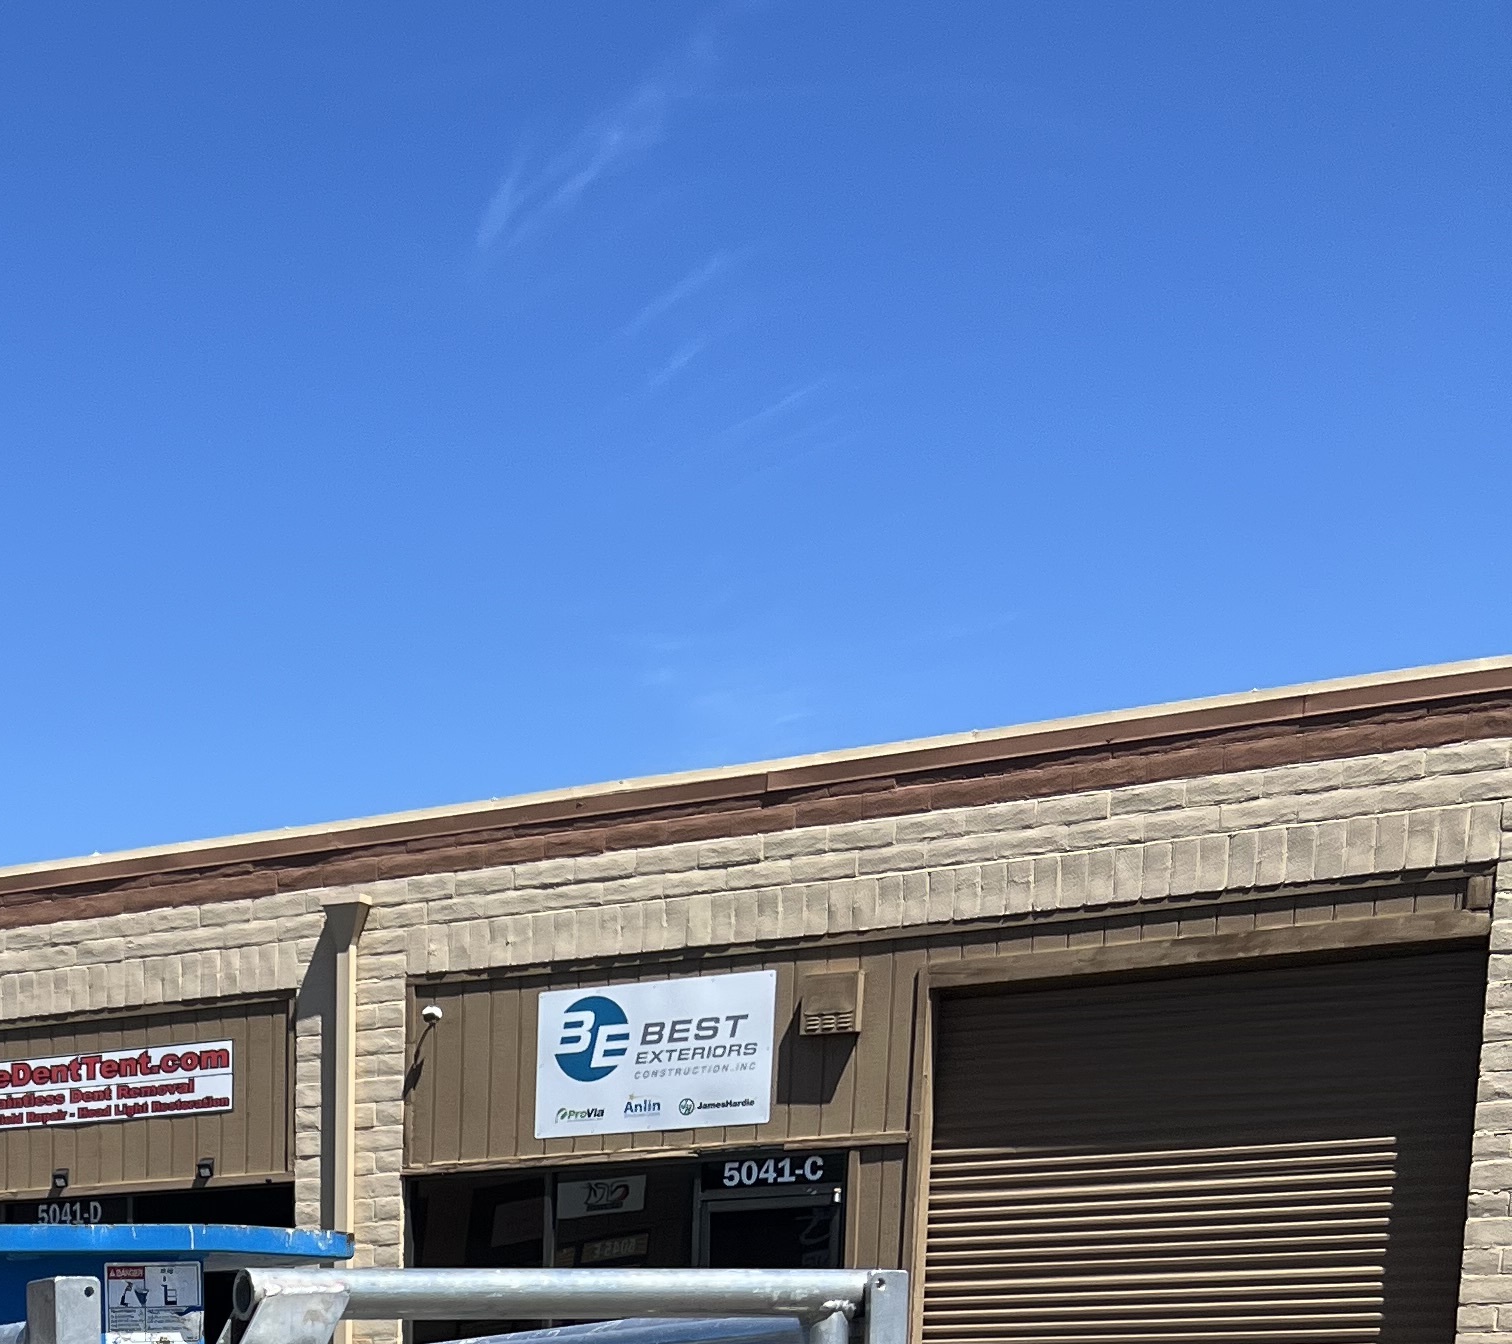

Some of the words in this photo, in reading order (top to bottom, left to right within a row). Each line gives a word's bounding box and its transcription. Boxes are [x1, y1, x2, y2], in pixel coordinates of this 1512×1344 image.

[640, 1013, 749, 1046] BEST
[635, 1042, 758, 1065] EXTERIORS
[69, 1085, 112, 1104] Dent
[116, 1077, 195, 1100] Removal
[26, 1109, 68, 1125] Repair
[77, 1104, 112, 1119] Head
[114, 1101, 149, 1118] Light
[624, 1100, 661, 1114] Anlin
[723, 1156, 824, 1187] 5041-C
[38, 1201, 102, 1225] 5041-D
